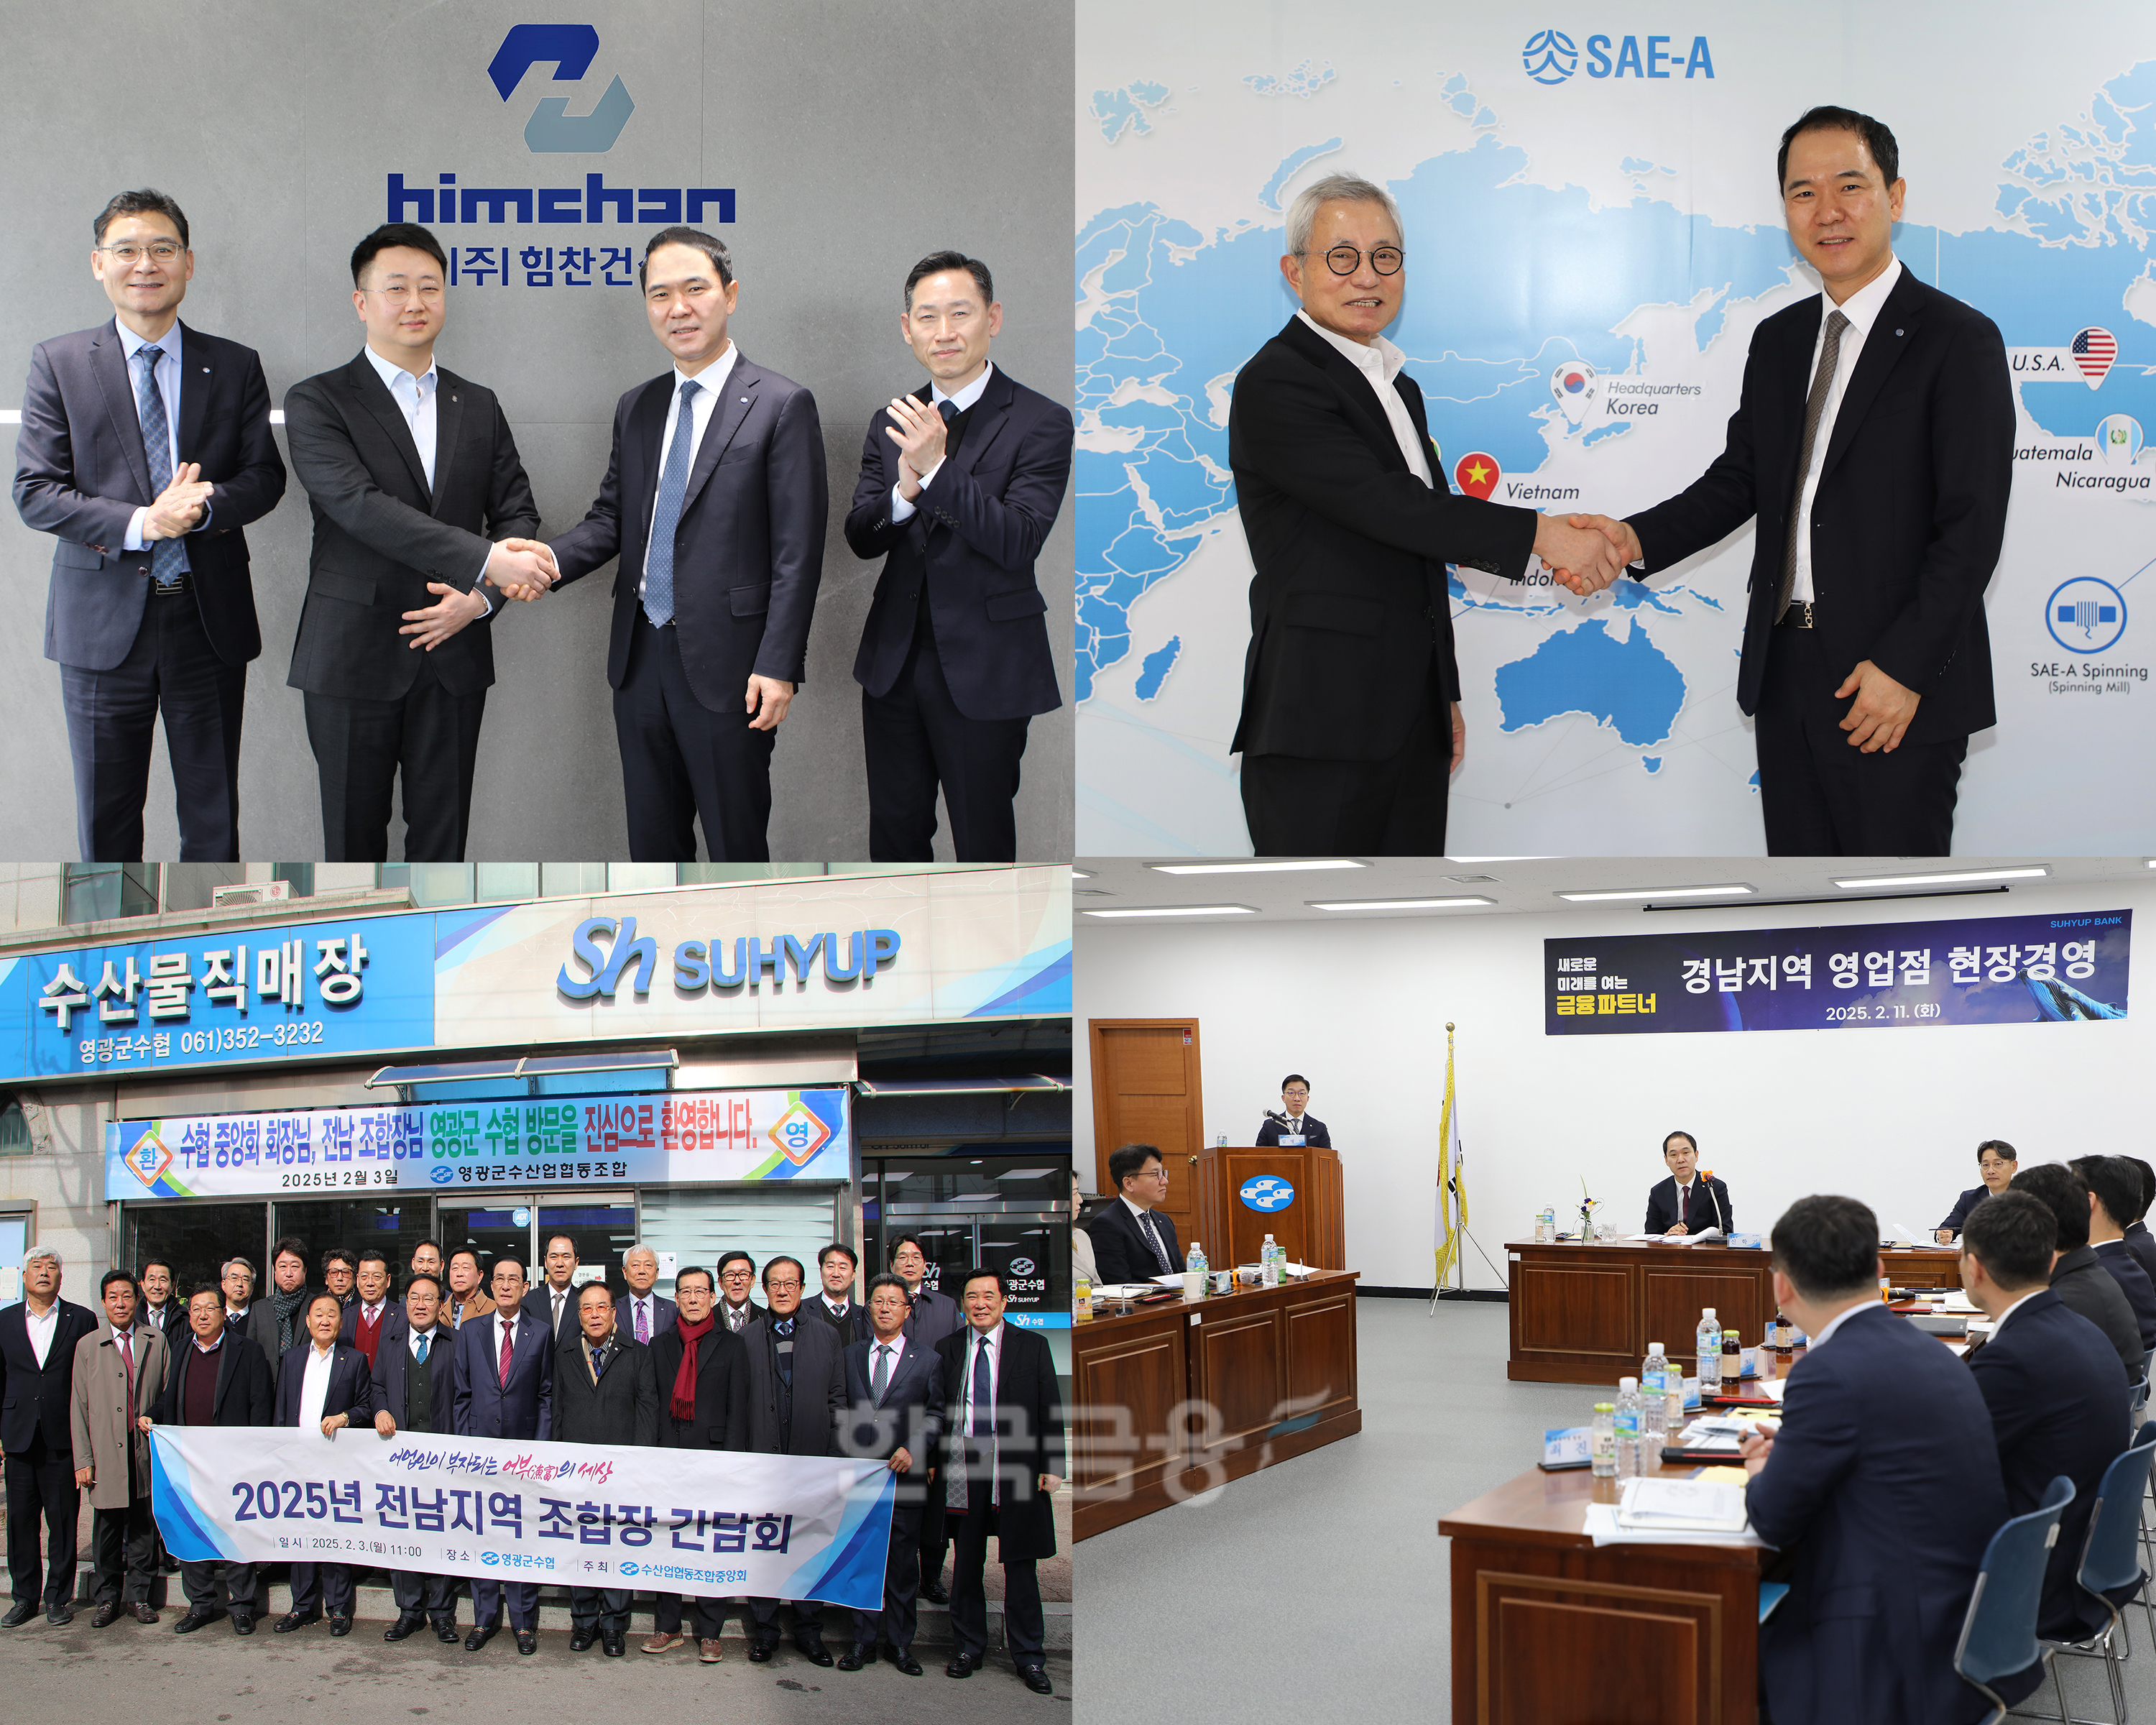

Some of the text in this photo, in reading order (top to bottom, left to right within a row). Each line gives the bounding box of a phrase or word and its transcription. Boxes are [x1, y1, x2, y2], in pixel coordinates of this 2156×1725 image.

[1586, 34, 1715, 78] SAE-A
[387, 173, 736, 223] himchan
[519, 245, 648, 287] 힘찬건
[2012, 354, 2065, 371] U.S.A.
[1607, 382, 1702, 398] Headquarters
[1606, 398, 1659, 415] Korea
[2012, 443, 2093, 460] uatemala
[1506, 483, 1580, 500] Vietnam
[2055, 472, 2151, 492] Nicaragua
[2031, 663, 2148, 681] SAE-A Spinning
[2048, 681, 2130, 694] (Spinning Mill)
[2050, 916, 2122, 928] SUHYUP BANK
[556, 916, 902, 999] Sh SUHYUP
[1557, 957, 1597, 972] 새로운
[1681, 940, 2096, 994] 경남지역 영업점 현장경영
[39, 933, 370, 1031] 수산물직매장
[1557, 975, 1628, 991] 미래를 여는
[1826, 1003, 1940, 1021] 2025. 2. 11. (화)
[79, 1021, 323, 1064] 영광군수협 061)352-3232
[180, 1098, 757, 1169] 수협 중앙회 회장님, 전남 조합장님 영광군 수협 방문을 진심으로 환영합니다.
[786, 1121, 808, 1148] 영
[139, 1148, 158, 1171] 환
[282, 1169, 397, 1187] 2025년 2월 3일
[458, 1161, 627, 1182] 영광군수산업협동조합
[1006, 1279, 1045, 1291] 광군수협
[1006, 1294, 1017, 1303] Sh
[1014, 1314, 1044, 1326] Sh 수협
[389, 1448, 446, 1471] 어업인이
[446, 1450, 498, 1475] 부자되는
[578, 1460, 613, 1484] 세상
[231, 1479, 793, 1555] 2025년 전남지역 조합장 간담회
[312, 1537, 343, 1550] 2025.
[345, 1540, 356, 1550] 2.
[390, 1545, 422, 1558] 11:00
[501, 1553, 555, 1570] 영광군수협
[641, 1563, 747, 1583] 수산업협동조합중앙회
